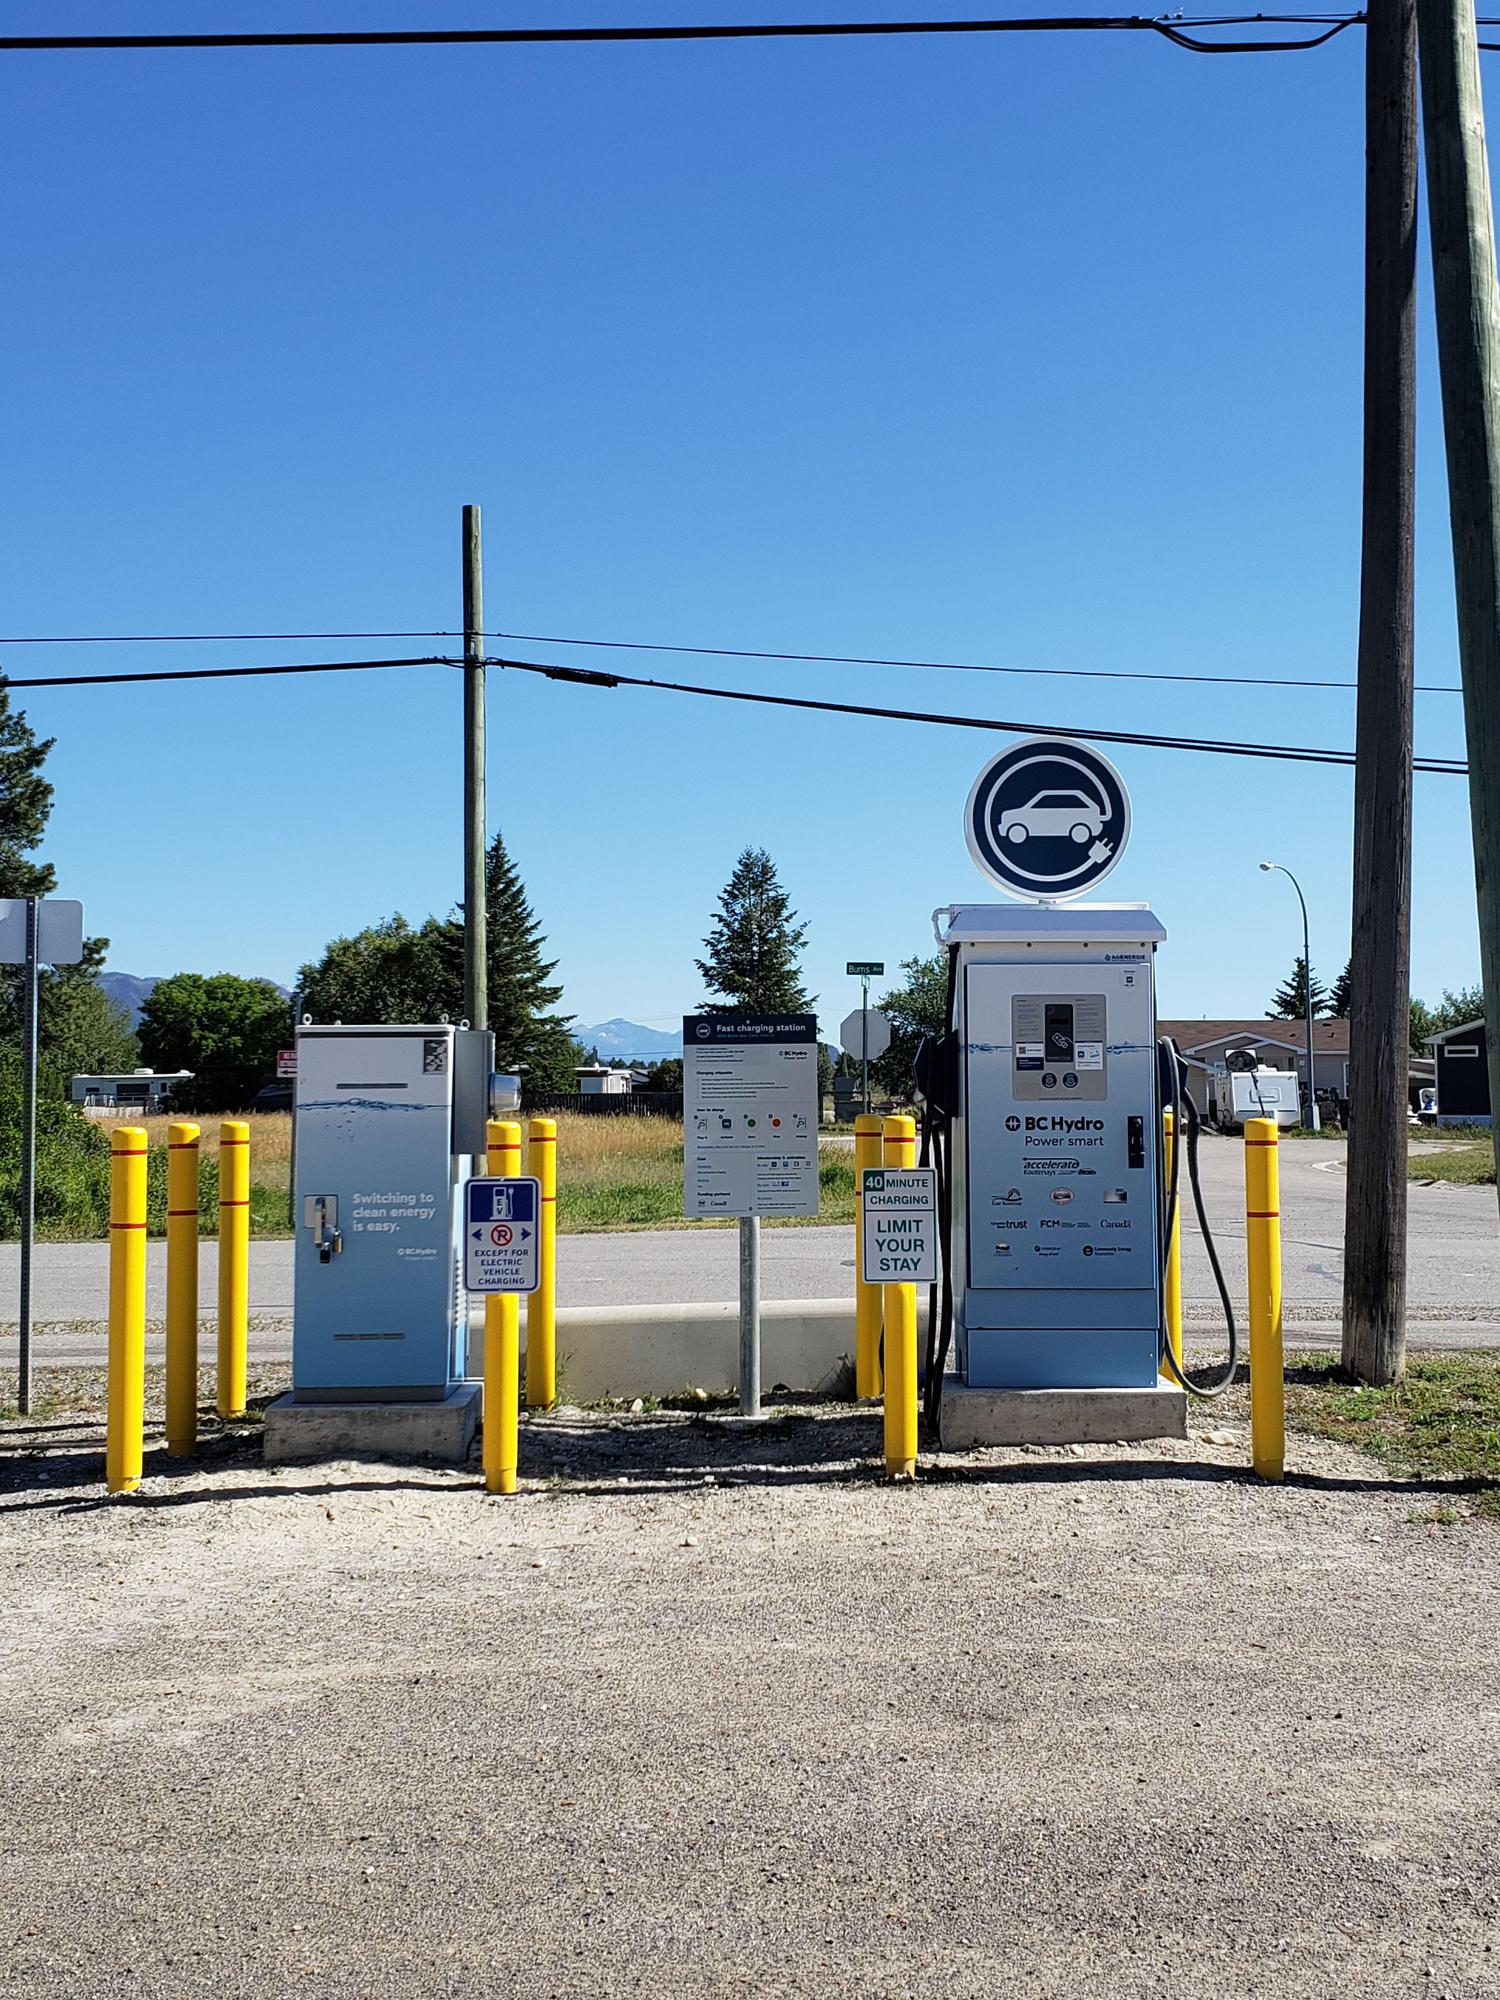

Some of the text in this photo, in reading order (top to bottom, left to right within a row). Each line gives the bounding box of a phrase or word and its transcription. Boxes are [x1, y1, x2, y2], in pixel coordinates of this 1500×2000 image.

[848, 964, 870, 974] Burns
[716, 1023, 806, 1034] Fast charging station
[1025, 1116, 1104, 1134] BC Hydro
[1025, 1135, 1104, 1147] Power smart
[1023, 1169, 1056, 1177] Kootenays
[865, 1176, 929, 1188] 40 MINUTE
[353, 1192, 434, 1206] Switching to
[870, 1195, 929, 1205] CHARGING
[353, 1207, 436, 1219] clean energy
[353, 1220, 400, 1233] is easy.
[877, 1219, 923, 1233] LIMIT
[1006, 1219, 1028, 1229] trust
[1040, 1219, 1060, 1229] FCM
[875, 1239, 925, 1252] YOUR
[480, 1258, 522, 1266] ELECTRIC
[879, 1257, 921, 1272] STAY
[478, 1277, 526, 1285] CHARGING
